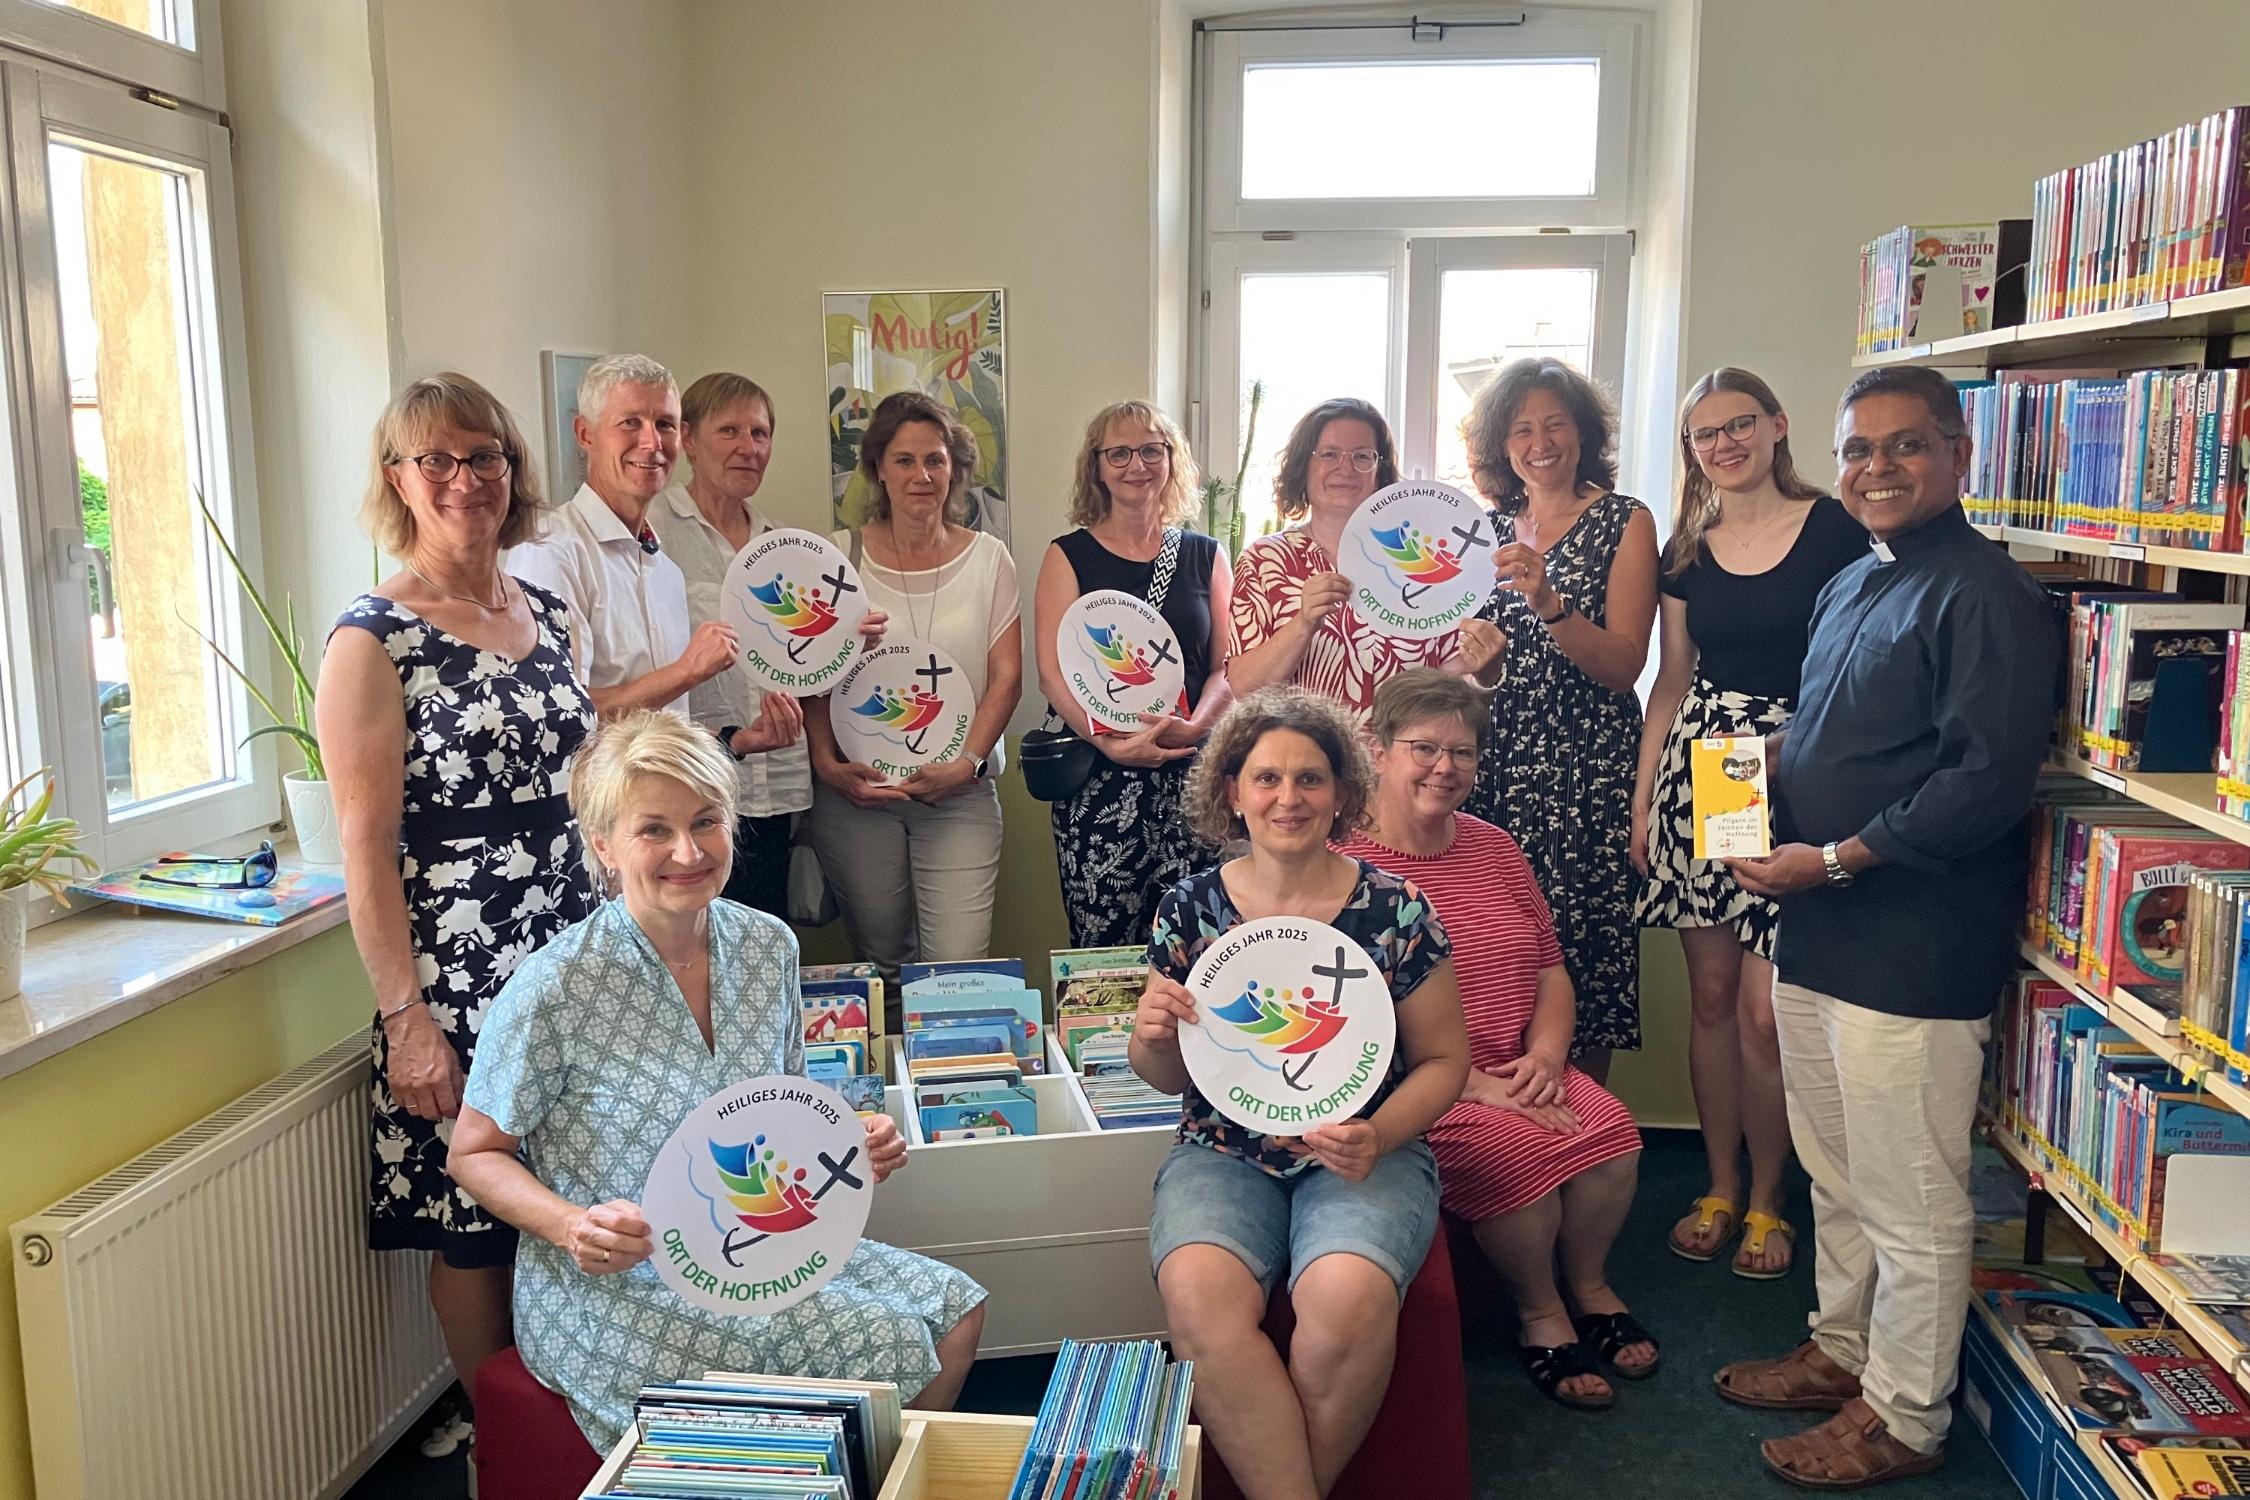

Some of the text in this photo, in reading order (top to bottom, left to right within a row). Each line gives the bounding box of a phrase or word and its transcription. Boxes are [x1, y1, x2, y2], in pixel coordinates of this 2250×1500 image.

[1948, 256, 1982, 268] HERZEN
[871, 312, 979, 380] Mutig!
[2219, 447, 2228, 476] NICHT
[1369, 489, 1460, 515] HEILIGES JAHR 2025
[743, 537, 824, 570] HEILIGES JAHR 2025
[1084, 597, 1157, 624] HEILIGES JAHR 2025
[1358, 587, 1477, 630] ORT DER HOFFNUNG
[747, 638, 856, 687] ORT DER HOFFNUNG
[840, 645, 910, 696] HEILIGES JAHR 2025
[1073, 672, 1165, 723] ORT DER HOFFNG
[872, 758, 897, 777] ORT
[931, 714, 967, 763] OFFNUNG
[2140, 867, 2177, 888] BULLY
[1200, 928, 1308, 989] HEILIGES JAHR 2025
[960, 979, 985, 989] großes
[1228, 1041, 1380, 1122] ORT DER HOFFNUNG
[717, 1088, 841, 1126] HEILIGES JAHR 2025
[2164, 1127, 2223, 1139] Kira und
[663, 1227, 828, 1302] ORT DER HOFFNUNG
[2157, 1369, 2210, 1415] RECORDS
[2171, 1369, 2224, 1414] WORLD
[2187, 1367, 2240, 1414] GUINNESS
